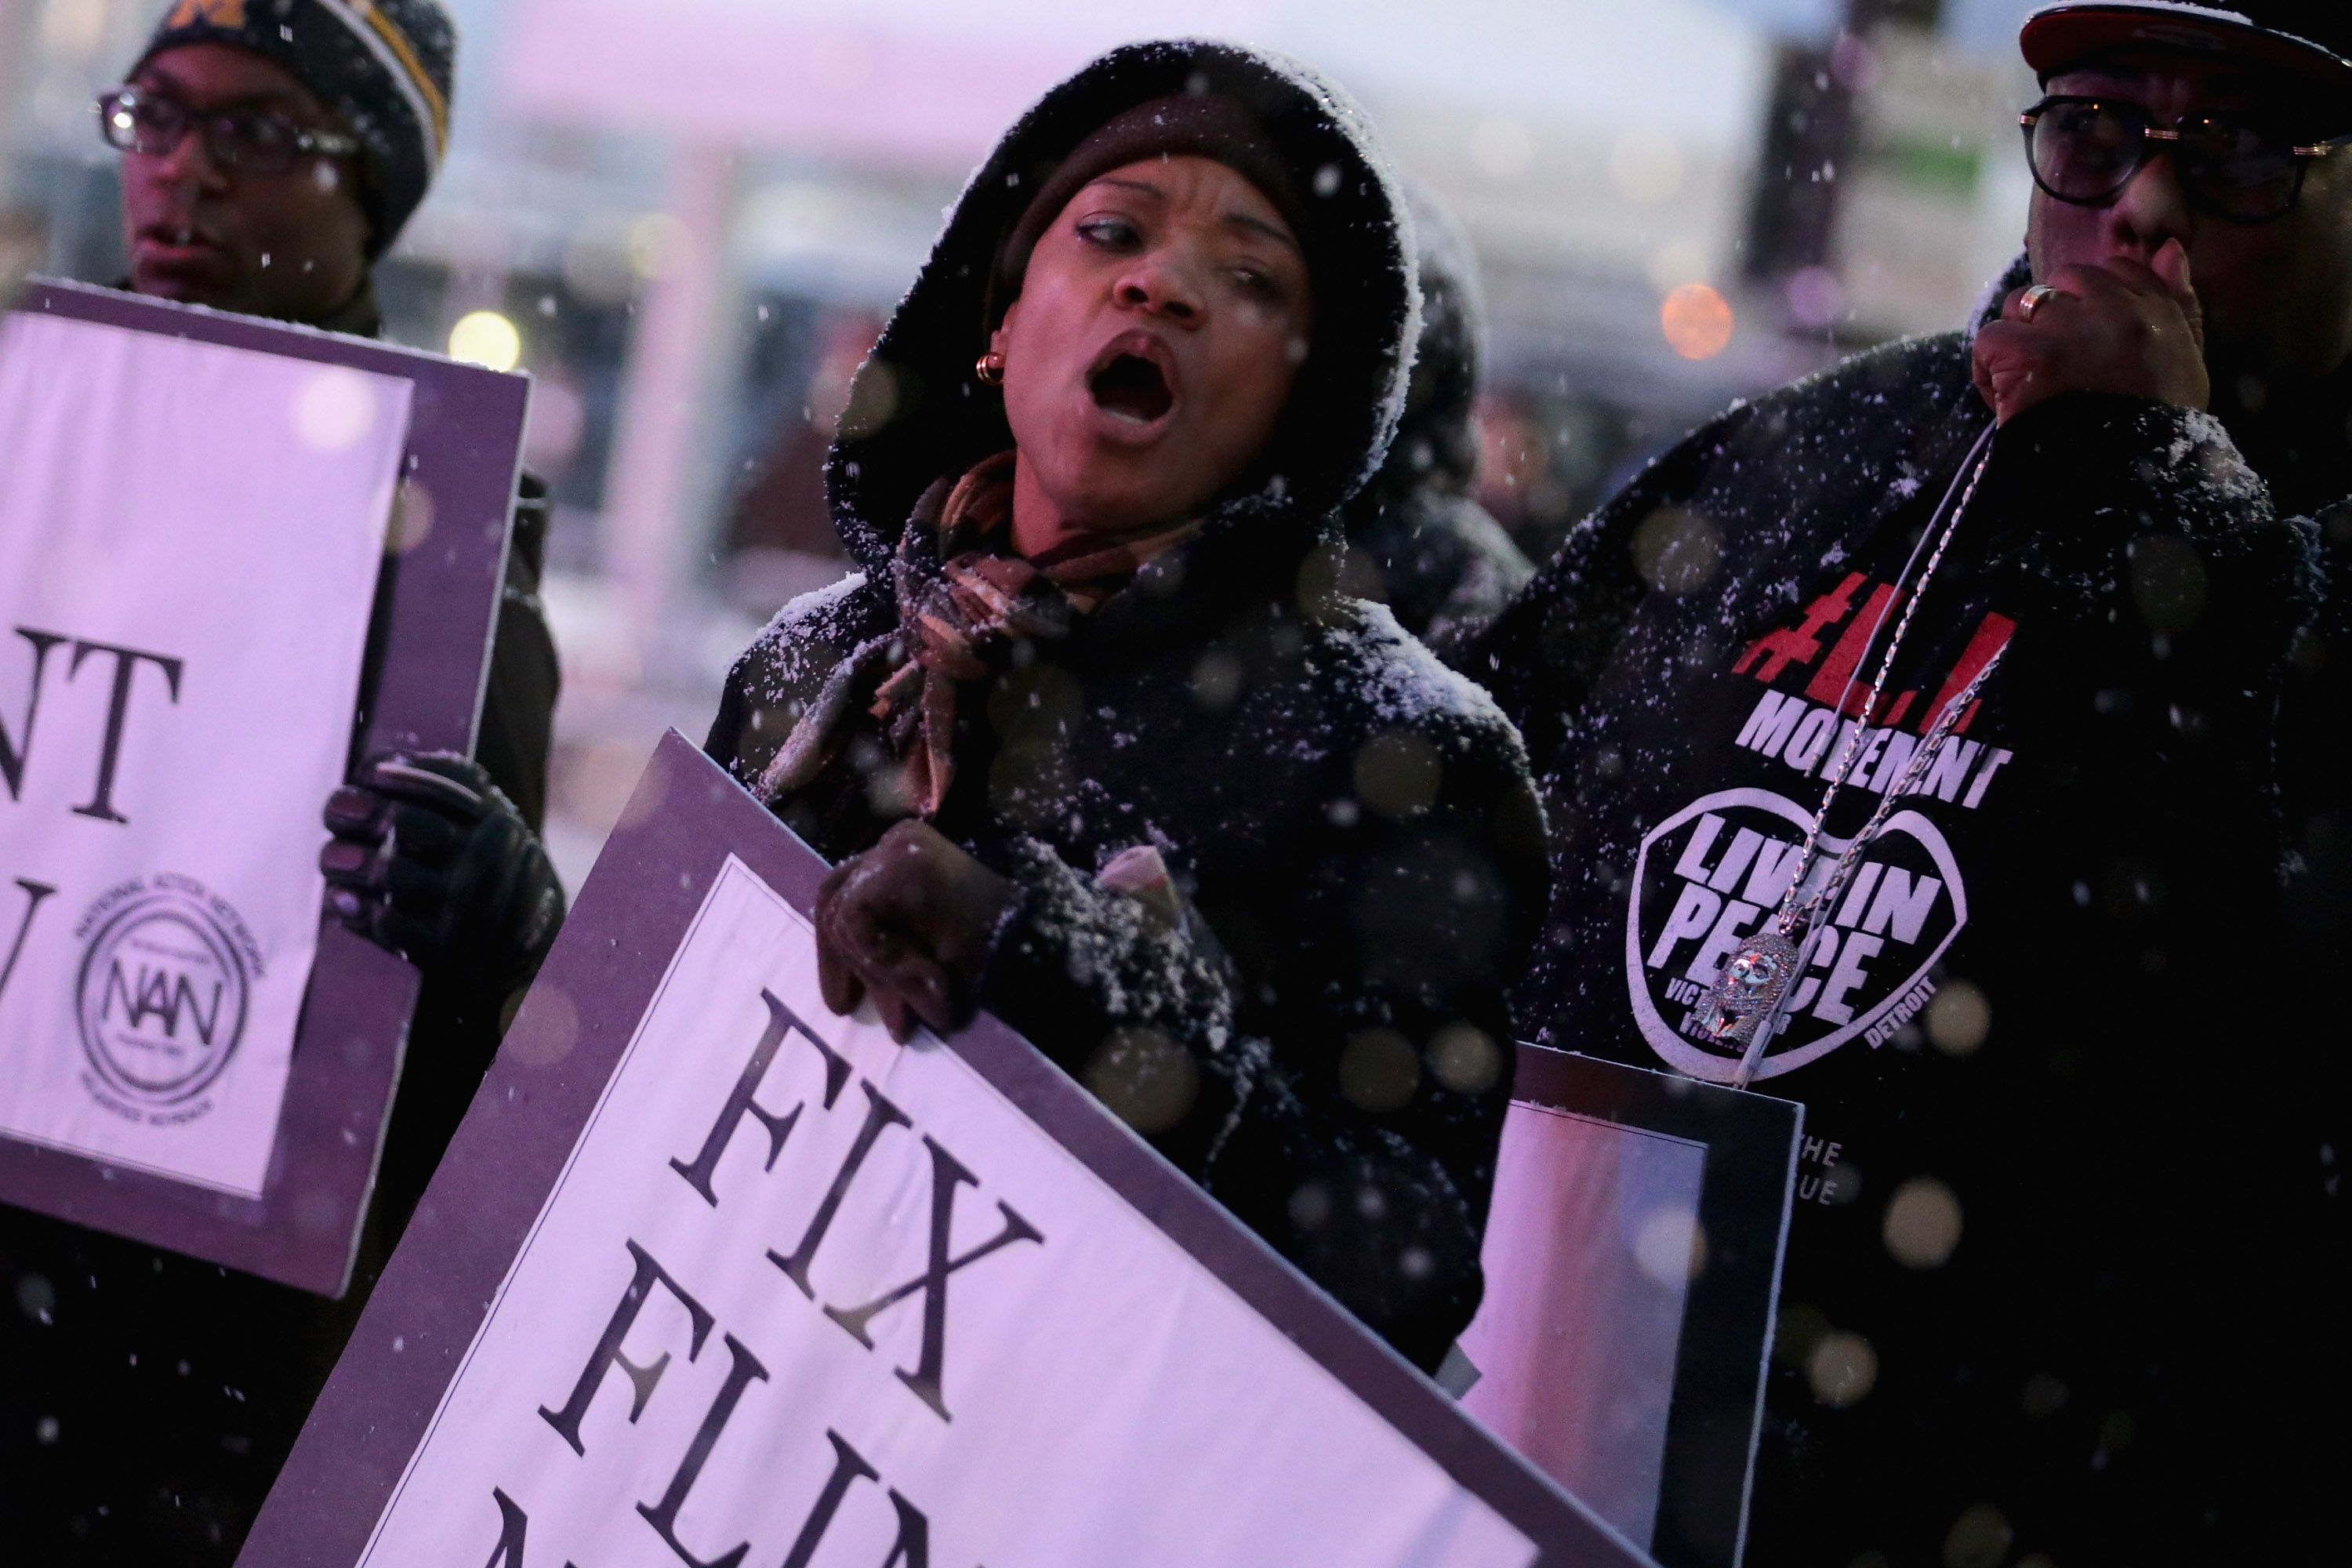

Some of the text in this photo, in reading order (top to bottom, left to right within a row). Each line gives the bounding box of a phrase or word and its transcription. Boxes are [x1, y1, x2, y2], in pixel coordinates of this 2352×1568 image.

[1735, 688, 2013, 809] MOVEMNT
[1835, 862, 1941, 946] IN
[1647, 881, 1884, 1026] PECE
[102, 957, 223, 1046] NAN
[1864, 975, 1937, 1050] DETROIT
[1801, 1134, 1843, 1167] HE
[669, 988, 1045, 1424] FIX
